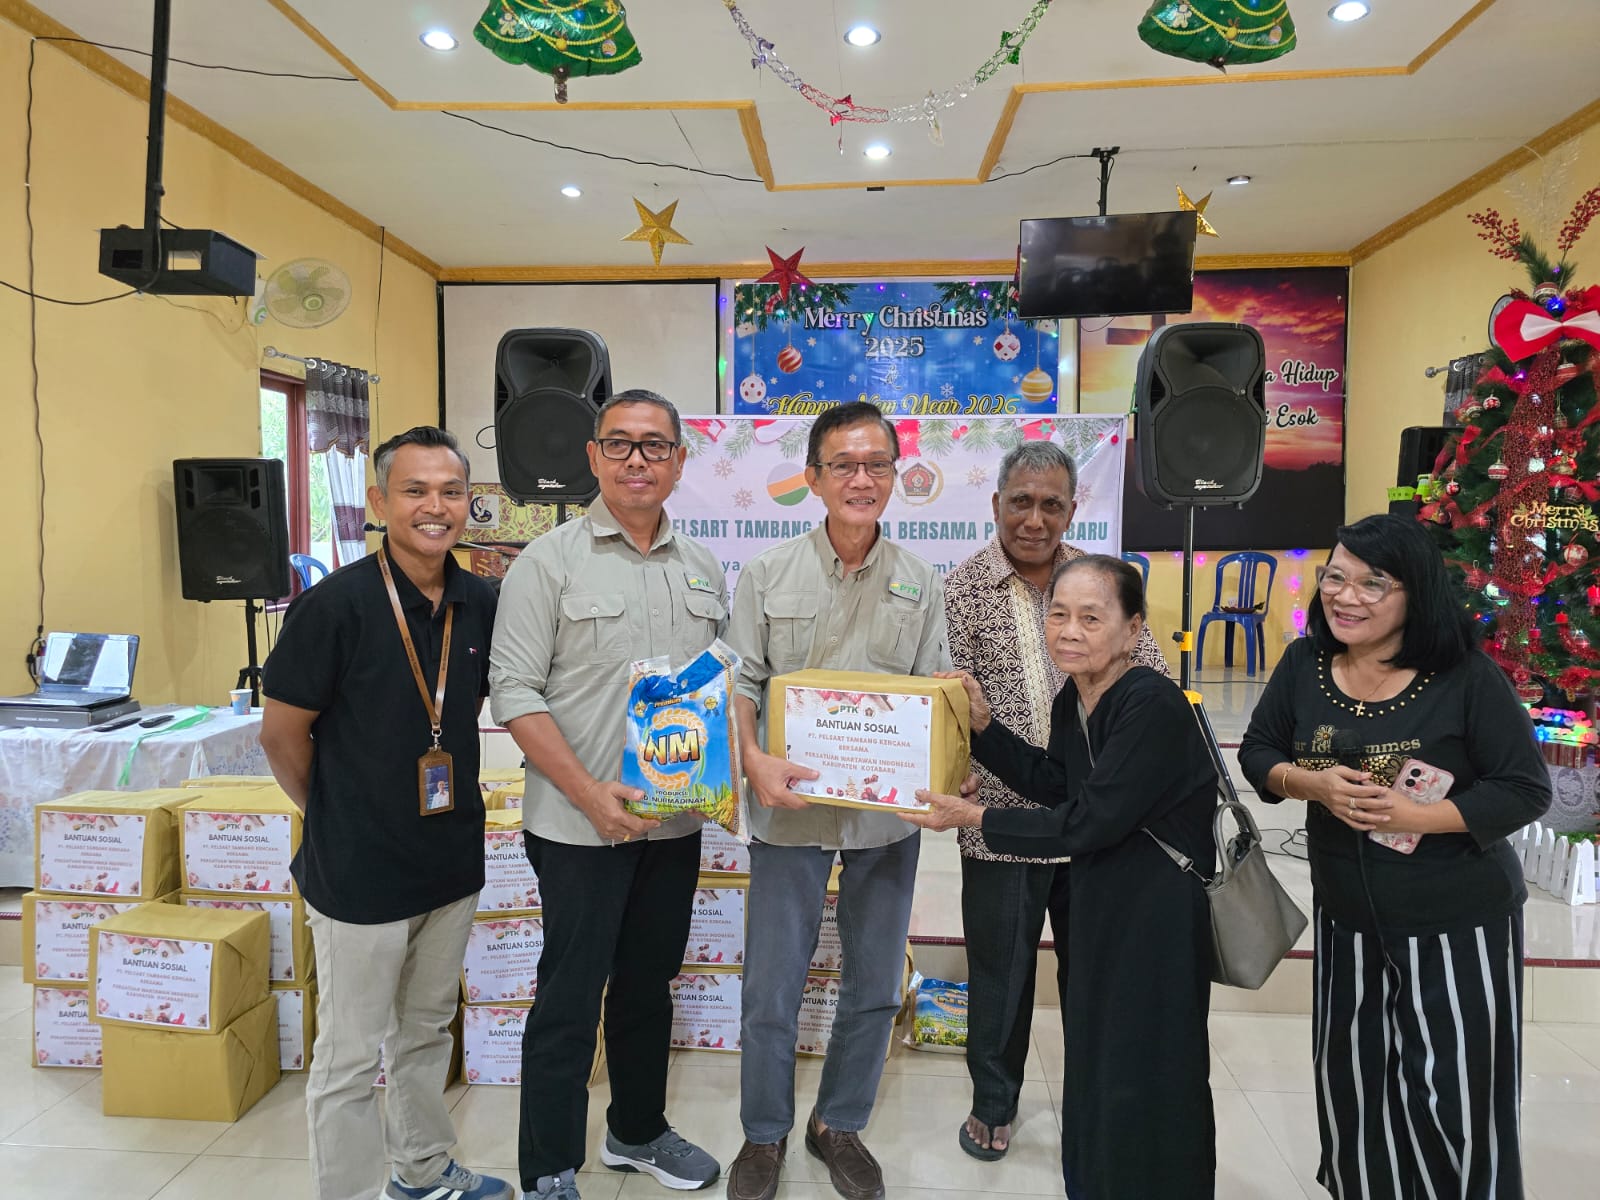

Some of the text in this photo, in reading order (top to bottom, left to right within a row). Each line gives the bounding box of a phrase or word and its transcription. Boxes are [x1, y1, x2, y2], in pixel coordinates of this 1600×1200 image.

[804, 302, 988, 337] Merry Christmas
[865, 336, 925, 358] 2025
[1280, 359, 1339, 392] Hidup
[903, 394, 961, 415] Year
[963, 395, 1021, 415] 2026
[1275, 403, 1319, 430] Esok
[1529, 500, 1586, 520] Merry
[672, 519, 728, 538] ELSART
[898, 521, 977, 540] BERSAMA
[1061, 522, 1108, 541] BARU
[1510, 514, 1599, 532] Christmas
[840, 705, 858, 714] PTK
[816, 718, 899, 735] BANTUAN SOSIAL
[644, 728, 700, 765] NM
[838, 744, 869, 752] BERSAMA
[846, 736, 878, 744] TAMBANG
[880, 739, 911, 748] KENCANA
[1364, 738, 1422, 754] mmes
[805, 752, 916, 768] PERSATUAN WARTAWAN INDONESIA
[822, 760, 896, 774] KABUPATEN KOTABARU
[64, 834, 122, 844] BANTUAN SOSIAL
[208, 834, 270, 843] BANTUAN SOSIAL
[486, 942, 522, 952] BANTUAN
[122, 958, 188, 972] BANTUAN SOSIAL
[698, 994, 724, 1002] SOSIAL
[802, 997, 828, 1006] NTUAN
